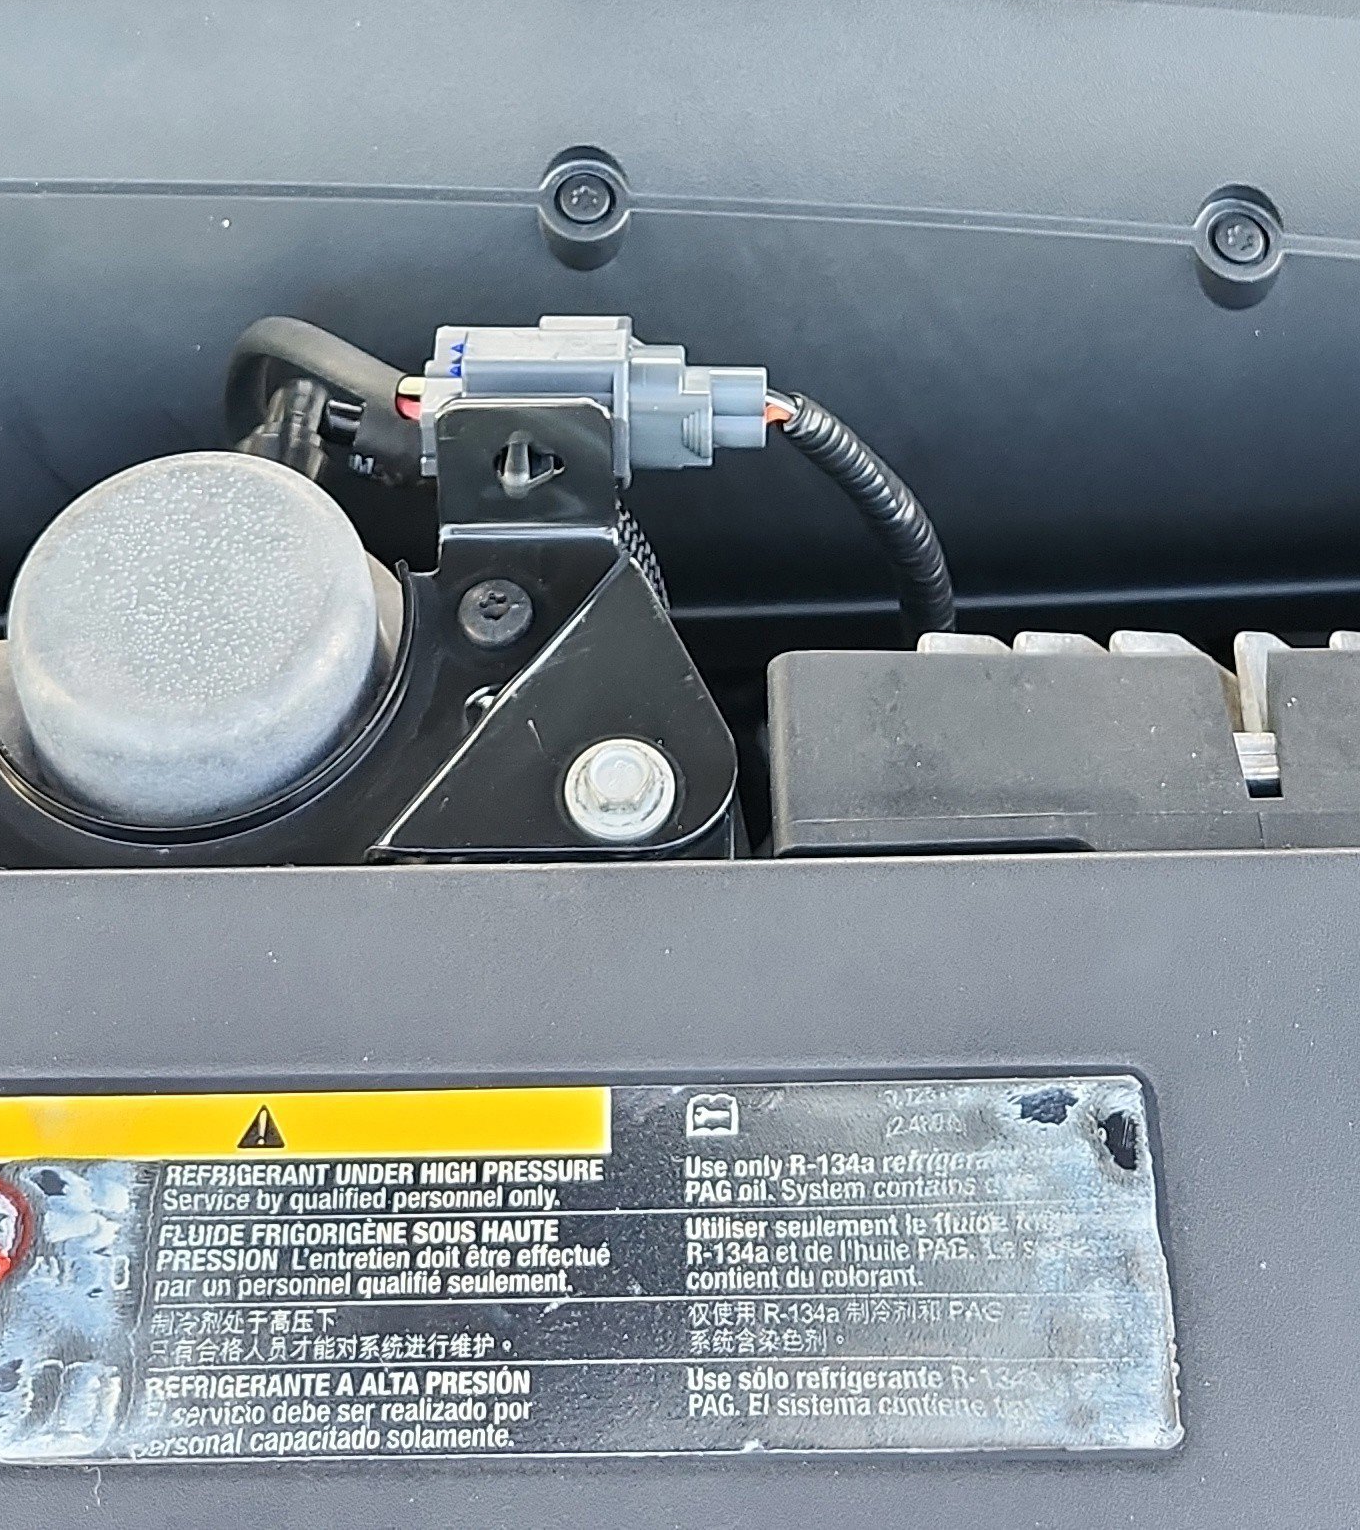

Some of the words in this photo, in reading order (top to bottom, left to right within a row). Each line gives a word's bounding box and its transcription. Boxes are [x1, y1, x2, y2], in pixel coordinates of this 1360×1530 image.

[164, 1163, 330, 1186] REFRIGERANT
[335, 1162, 414, 1185] UNDER
[420, 1161, 476, 1184] HIGH
[482, 1159, 604, 1182] PRESSURE
[685, 1155, 728, 1178] Use
[734, 1154, 783, 1181] only
[790, 1152, 875, 1176] R-134a
[162, 1188, 250, 1211] Service
[256, 1189, 284, 1214] by
[290, 1187, 387, 1214] qualified
[392, 1185, 503, 1212] personnel
[508, 1184, 561, 1211] only.
[685, 1180, 732, 1202] PAG
[738, 1178, 776, 1201] oil.
[781, 1178, 865, 1205] System
[873, 1171, 976, 1198] contains
[159, 1223, 245, 1247] FLUIDE
[249, 1218, 407, 1246] FRIGORIGÈNE
[413, 1220, 476, 1244] SOUS
[482, 1219, 559, 1243] HAUTE
[686, 1217, 768, 1240] Utiliser
[775, 1215, 899, 1238] seulement
[905, 1213, 927, 1235] le
[156, 1248, 279, 1272] PRESSION
[292, 1246, 410, 1270] L'entretien
[416, 1245, 460, 1269] doit
[466, 1244, 511, 1268] être
[516, 1242, 610, 1268] effectué
[687, 1241, 769, 1265] R-134a
[776, 1242, 798, 1263] et
[805, 1240, 833, 1263] de
[840, 1239, 910, 1262] l'huile
[918, 1237, 975, 1261] PAG.
[155, 1277, 196, 1301] par
[202, 1277, 231, 1297] un
[238, 1272, 350, 1300] personnel
[358, 1271, 441, 1298] qualifié
[447, 1270, 573, 1294] seulement.
[687, 1266, 779, 1290] contient
[786, 1265, 814, 1287] du
[822, 1264, 924, 1288] colorant.
[150, 1308, 337, 1335] 制冷剂处于高压下
[689, 1301, 756, 1327] 仅使用
[764, 1303, 839, 1324] R-134a
[846, 1299, 940, 1325] 制冷剂和
[949, 1300, 1004, 1323] PAG
[145, 1373, 330, 1400] REFRIGERANTE
[335, 1372, 354, 1397] A
[360, 1371, 419, 1396] ALTA
[425, 1365, 531, 1395] PRESIÓN
[687, 1366, 731, 1391] Use
[738, 1365, 789, 1391] sólo
[796, 1365, 942, 1394] refrigerante
[171, 1400, 265, 1427] servicio
[273, 1399, 331, 1424] debe
[337, 1402, 376, 1423] ser
[381, 1397, 487, 1423] realizado
[493, 1400, 533, 1425] por
[689, 1393, 740, 1417] PAG.
[748, 1392, 769, 1416] El
[777, 1394, 871, 1417] sistema
[878, 1391, 988, 1418] contiene
[130, 1427, 243, 1460] personal
[250, 1423, 381, 1455] capacitado
[386, 1423, 515, 1450] solamente.
